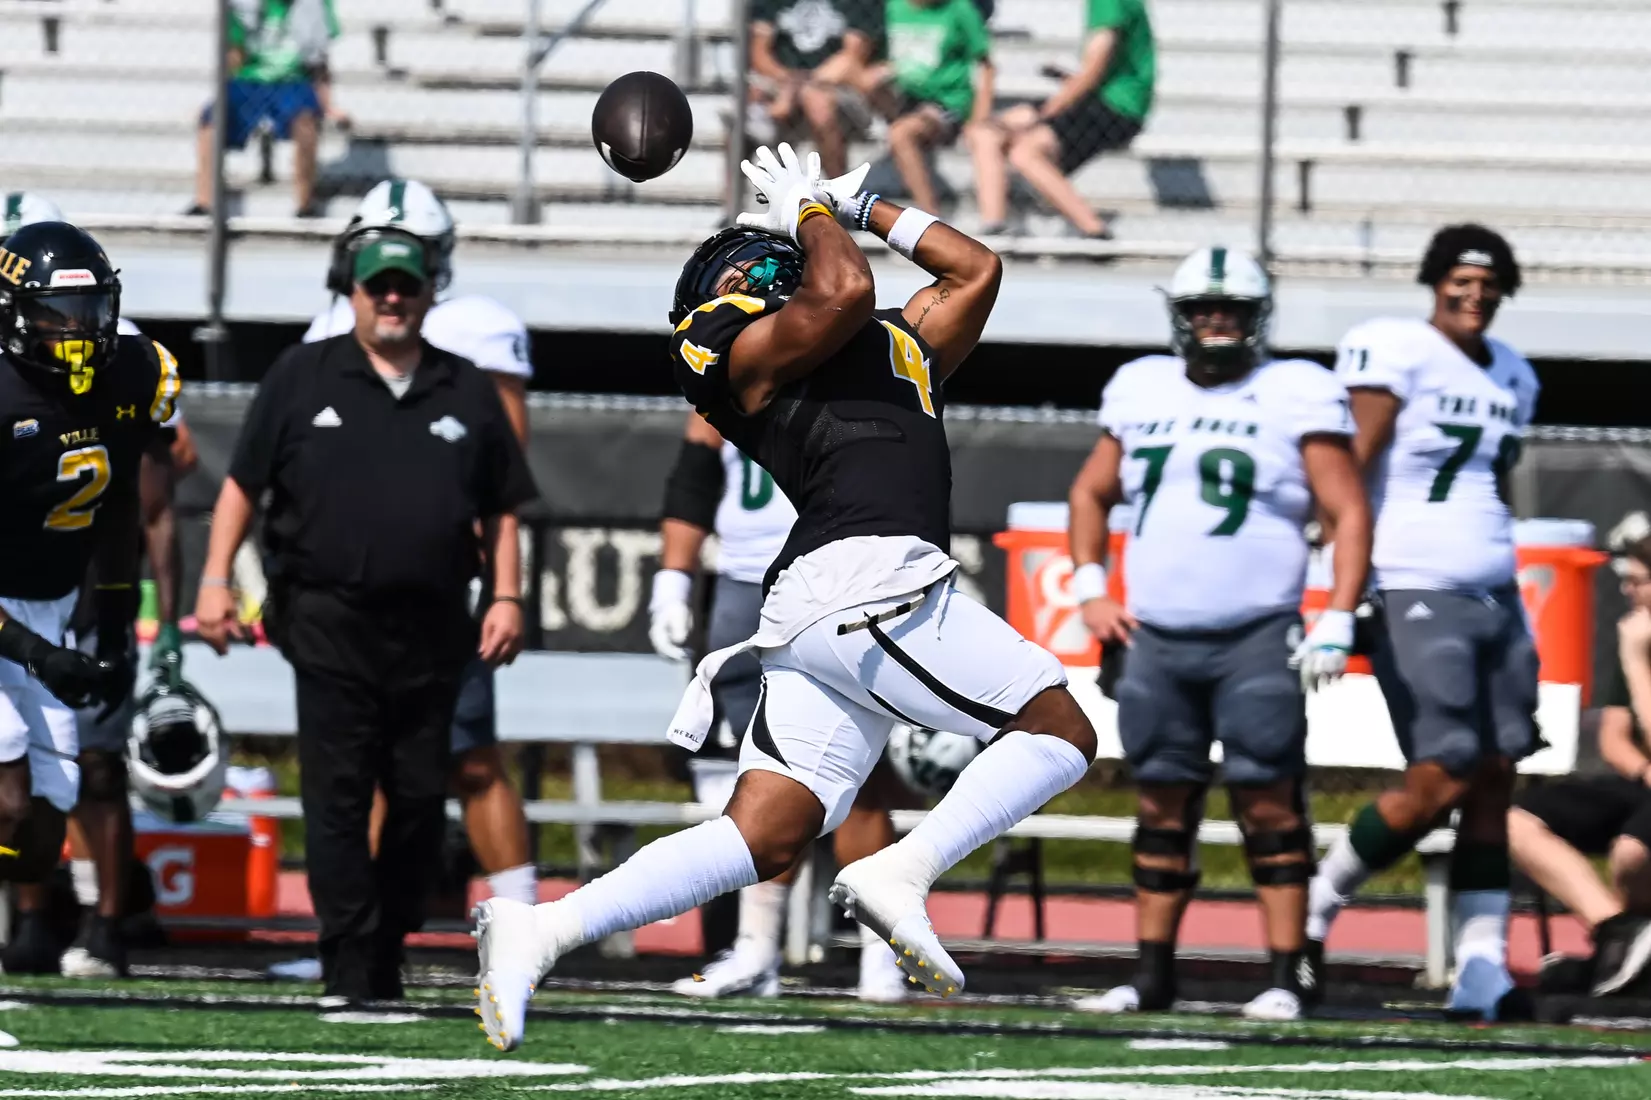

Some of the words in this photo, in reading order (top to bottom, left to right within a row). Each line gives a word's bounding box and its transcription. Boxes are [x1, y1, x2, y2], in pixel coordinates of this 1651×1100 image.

[680, 338, 720, 376] 4
[878, 319, 937, 419] 4
[58, 427, 100, 447] VILLE
[43, 444, 111, 532] 2
[1130, 443, 1256, 537] 79
[146, 844, 194, 906] G
